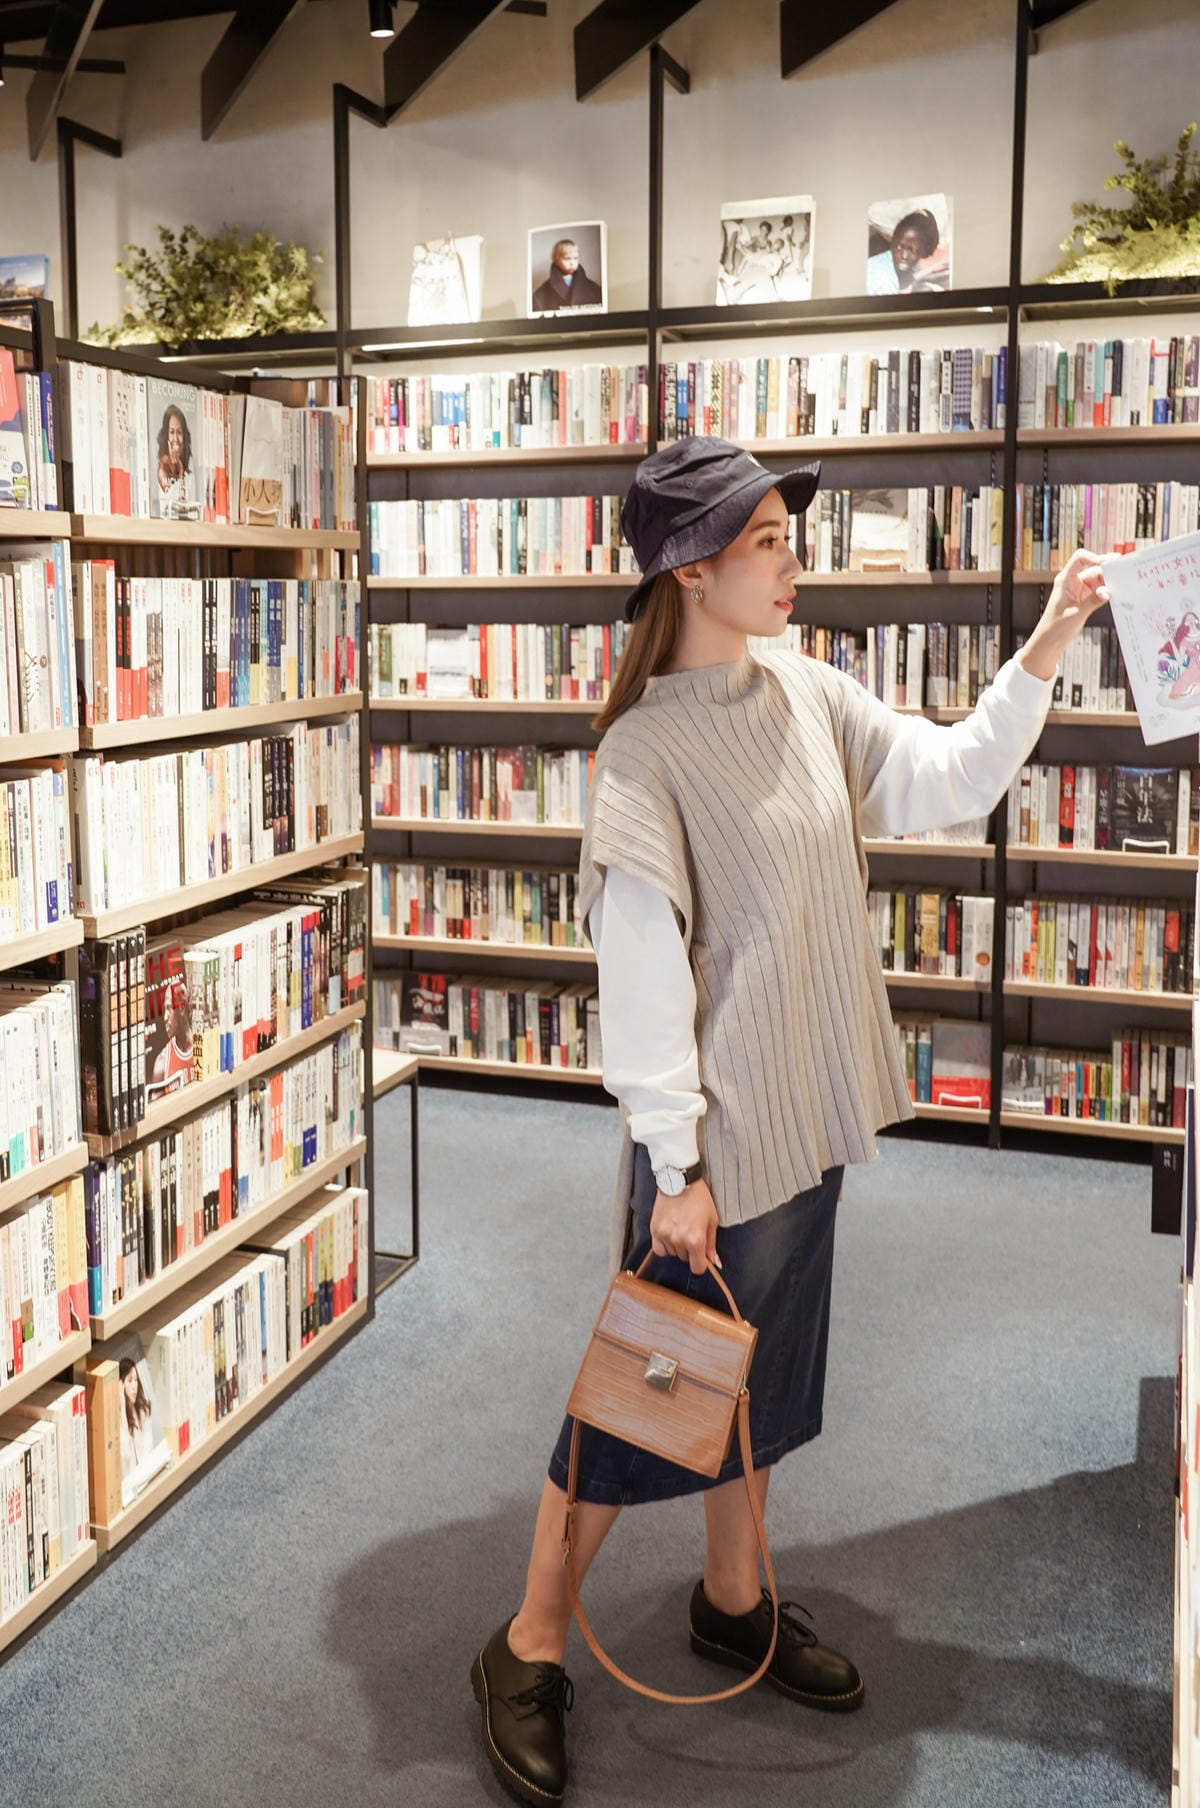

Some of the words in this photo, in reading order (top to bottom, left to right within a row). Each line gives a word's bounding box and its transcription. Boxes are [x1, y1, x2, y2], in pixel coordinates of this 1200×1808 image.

[151, 382, 196, 401] BECOMING
[148, 946, 183, 985] HE
[160, 973, 184, 987] JORDAN
[146, 981, 186, 1020] IFE
